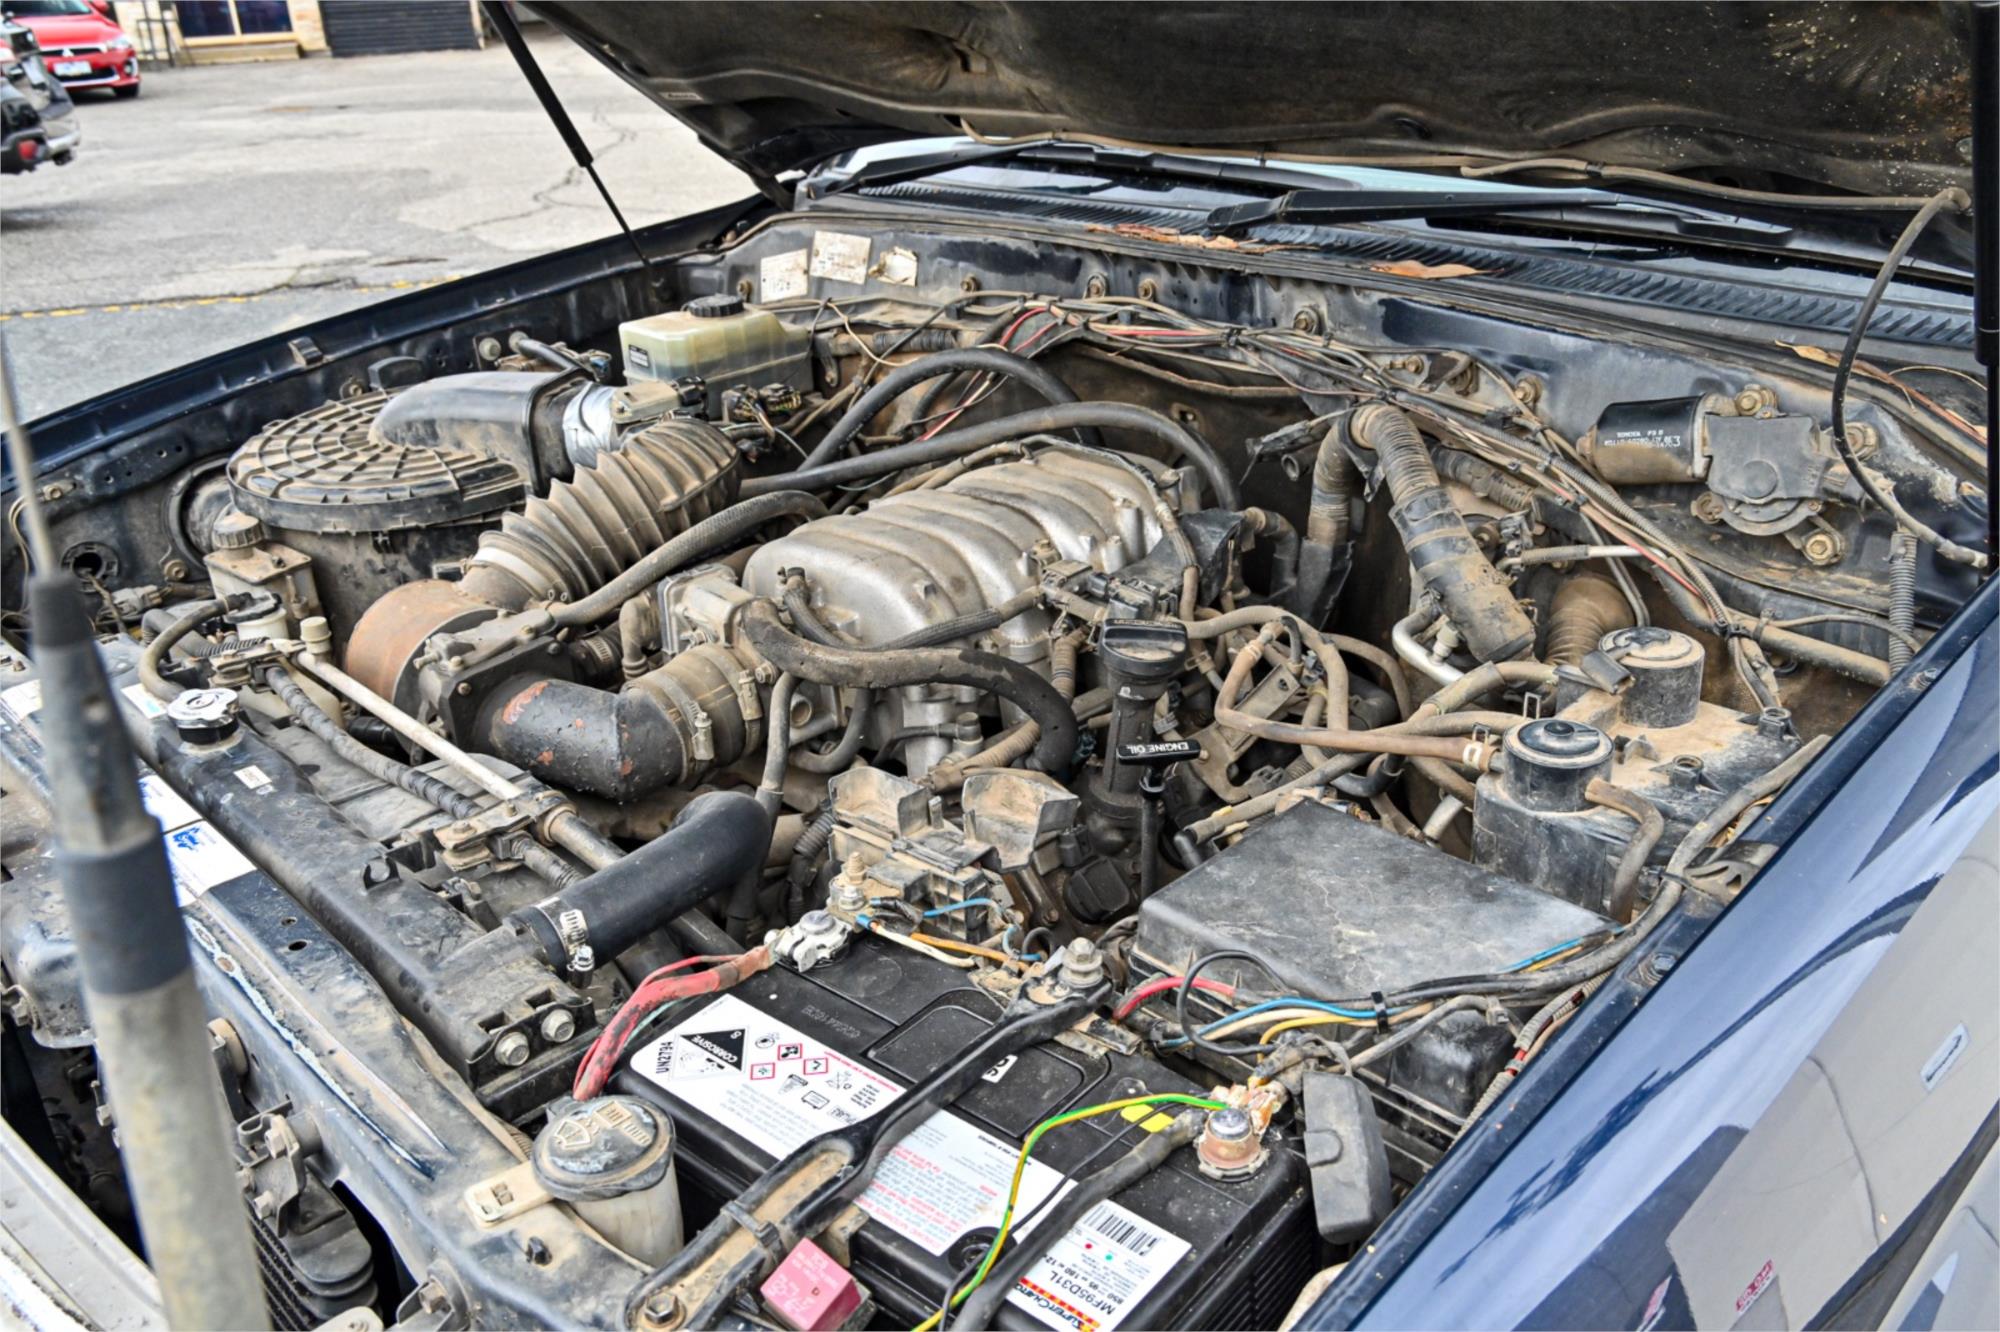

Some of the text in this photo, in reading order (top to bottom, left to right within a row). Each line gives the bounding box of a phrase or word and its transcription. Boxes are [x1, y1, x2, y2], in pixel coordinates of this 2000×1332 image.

[1126, 741, 1189, 754] ENGINE OIL
[729, 1030, 742, 1040] 8
[691, 1034, 738, 1064] CORROSIVE
[655, 1041, 674, 1075] UN2794
[1064, 1268, 1081, 1280] 180
[1049, 1269, 1117, 1316] MF95D31L
[1088, 1281, 1101, 1292] 95
[1107, 1292, 1125, 1306] 850
